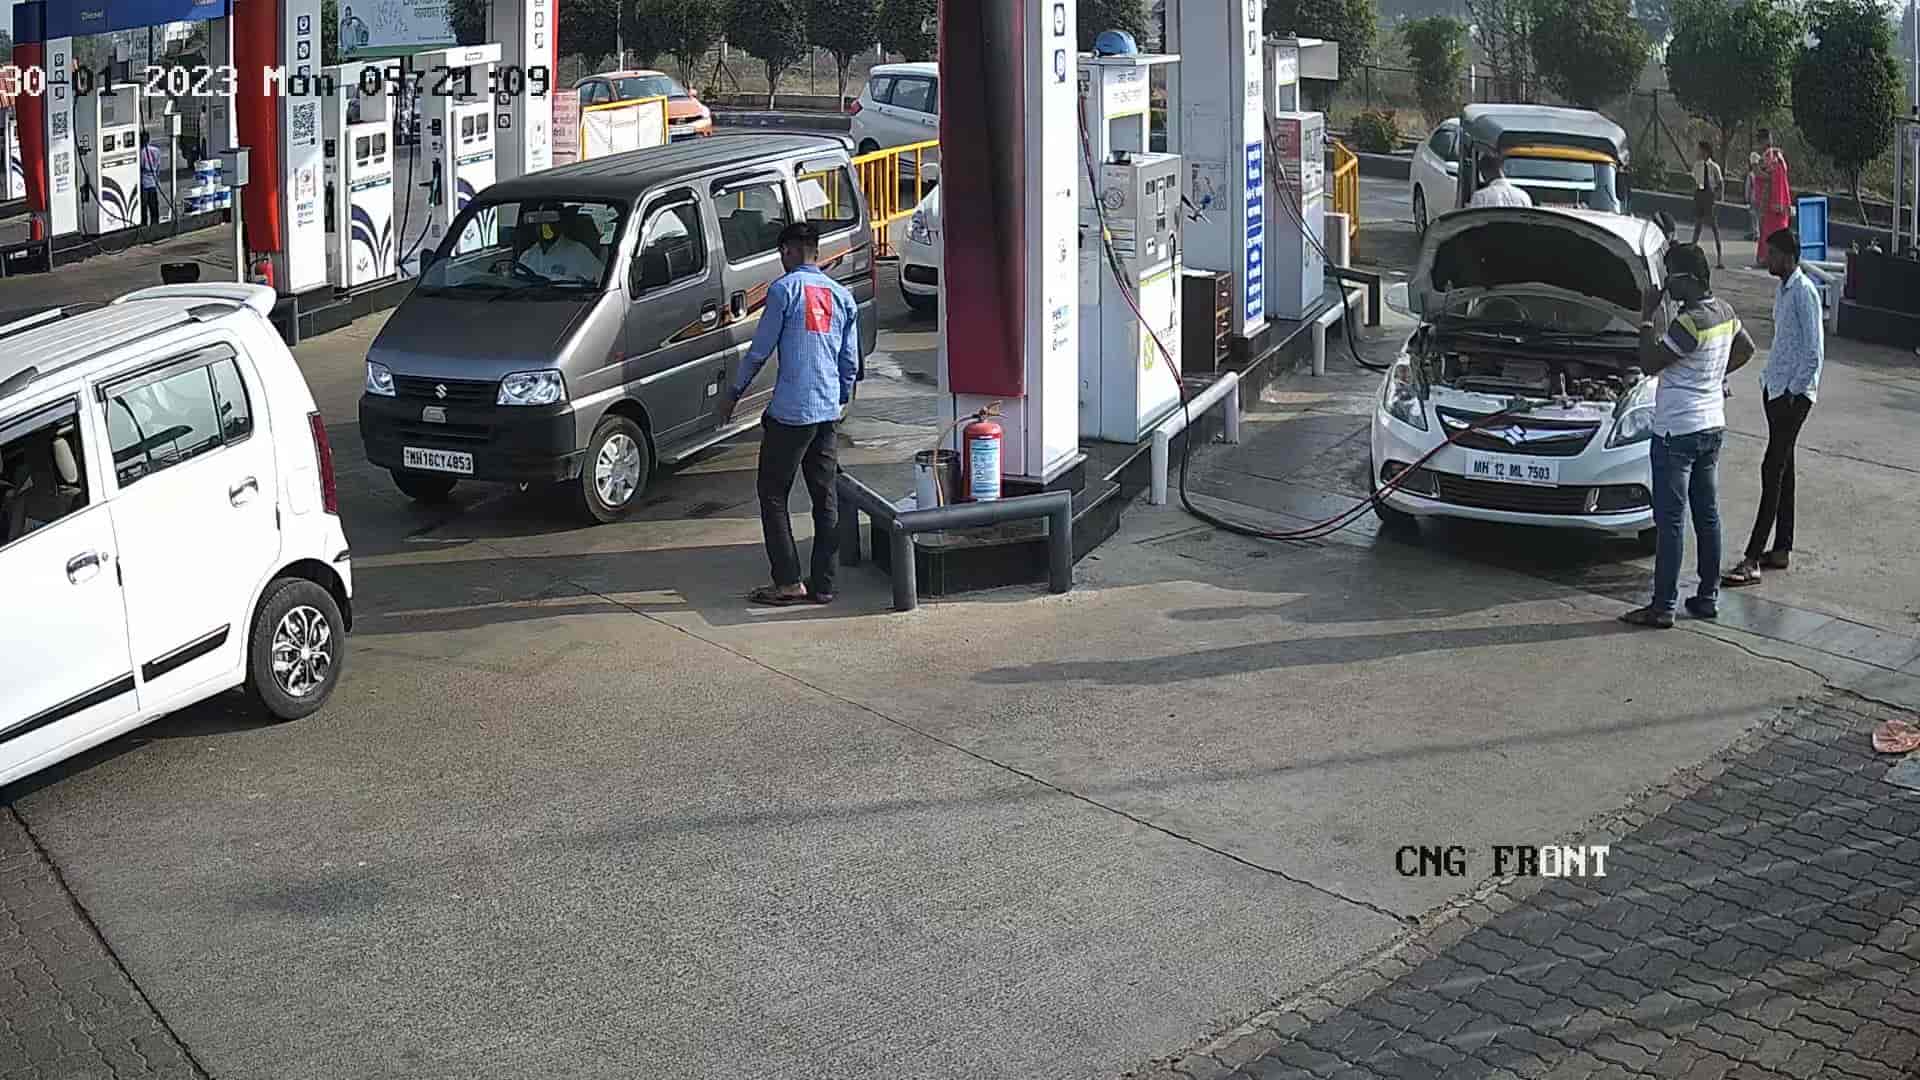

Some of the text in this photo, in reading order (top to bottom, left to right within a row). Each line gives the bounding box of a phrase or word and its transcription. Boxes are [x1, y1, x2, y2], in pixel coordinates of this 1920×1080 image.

[1473, 460, 1489, 474] MH
[1494, 463, 1505, 476] 12
[1527, 465, 1550, 480] 7503
